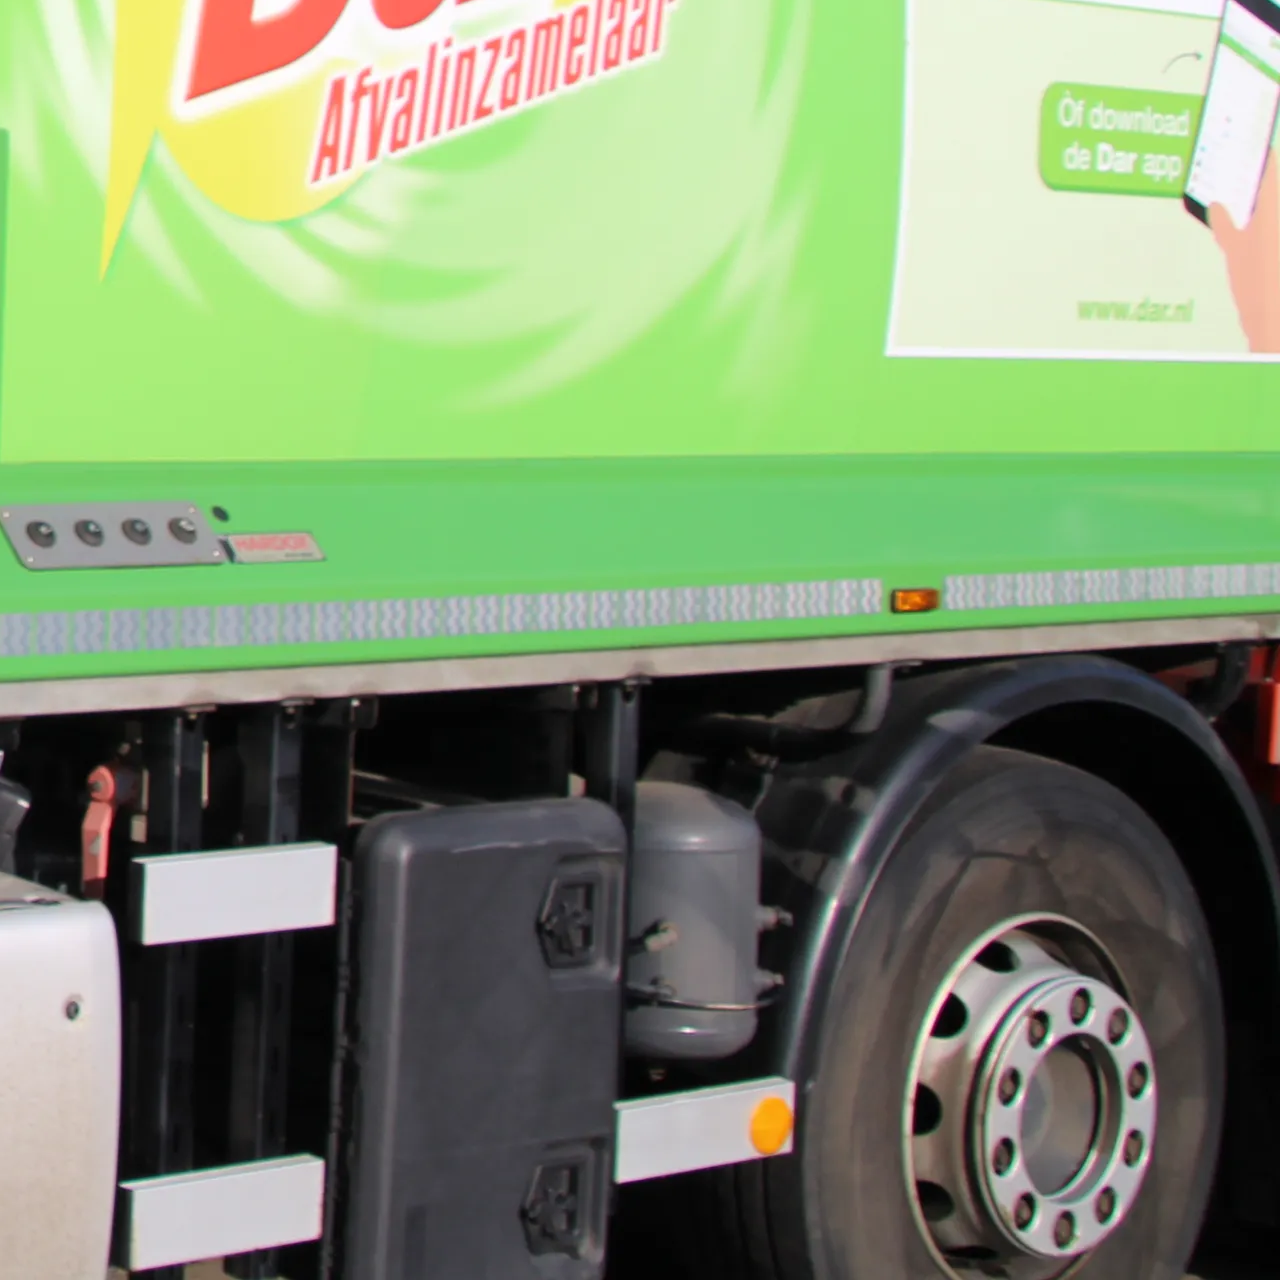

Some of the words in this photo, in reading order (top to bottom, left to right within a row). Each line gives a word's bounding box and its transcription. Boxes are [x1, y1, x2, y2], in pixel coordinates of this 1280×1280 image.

[1090, 100, 1190, 138] download
[1064, 142, 1092, 171] de
[1096, 142, 1138, 173] Dar
[1143, 152, 1183, 183] app
[1078, 296, 1194, 322] www.dar.nl
